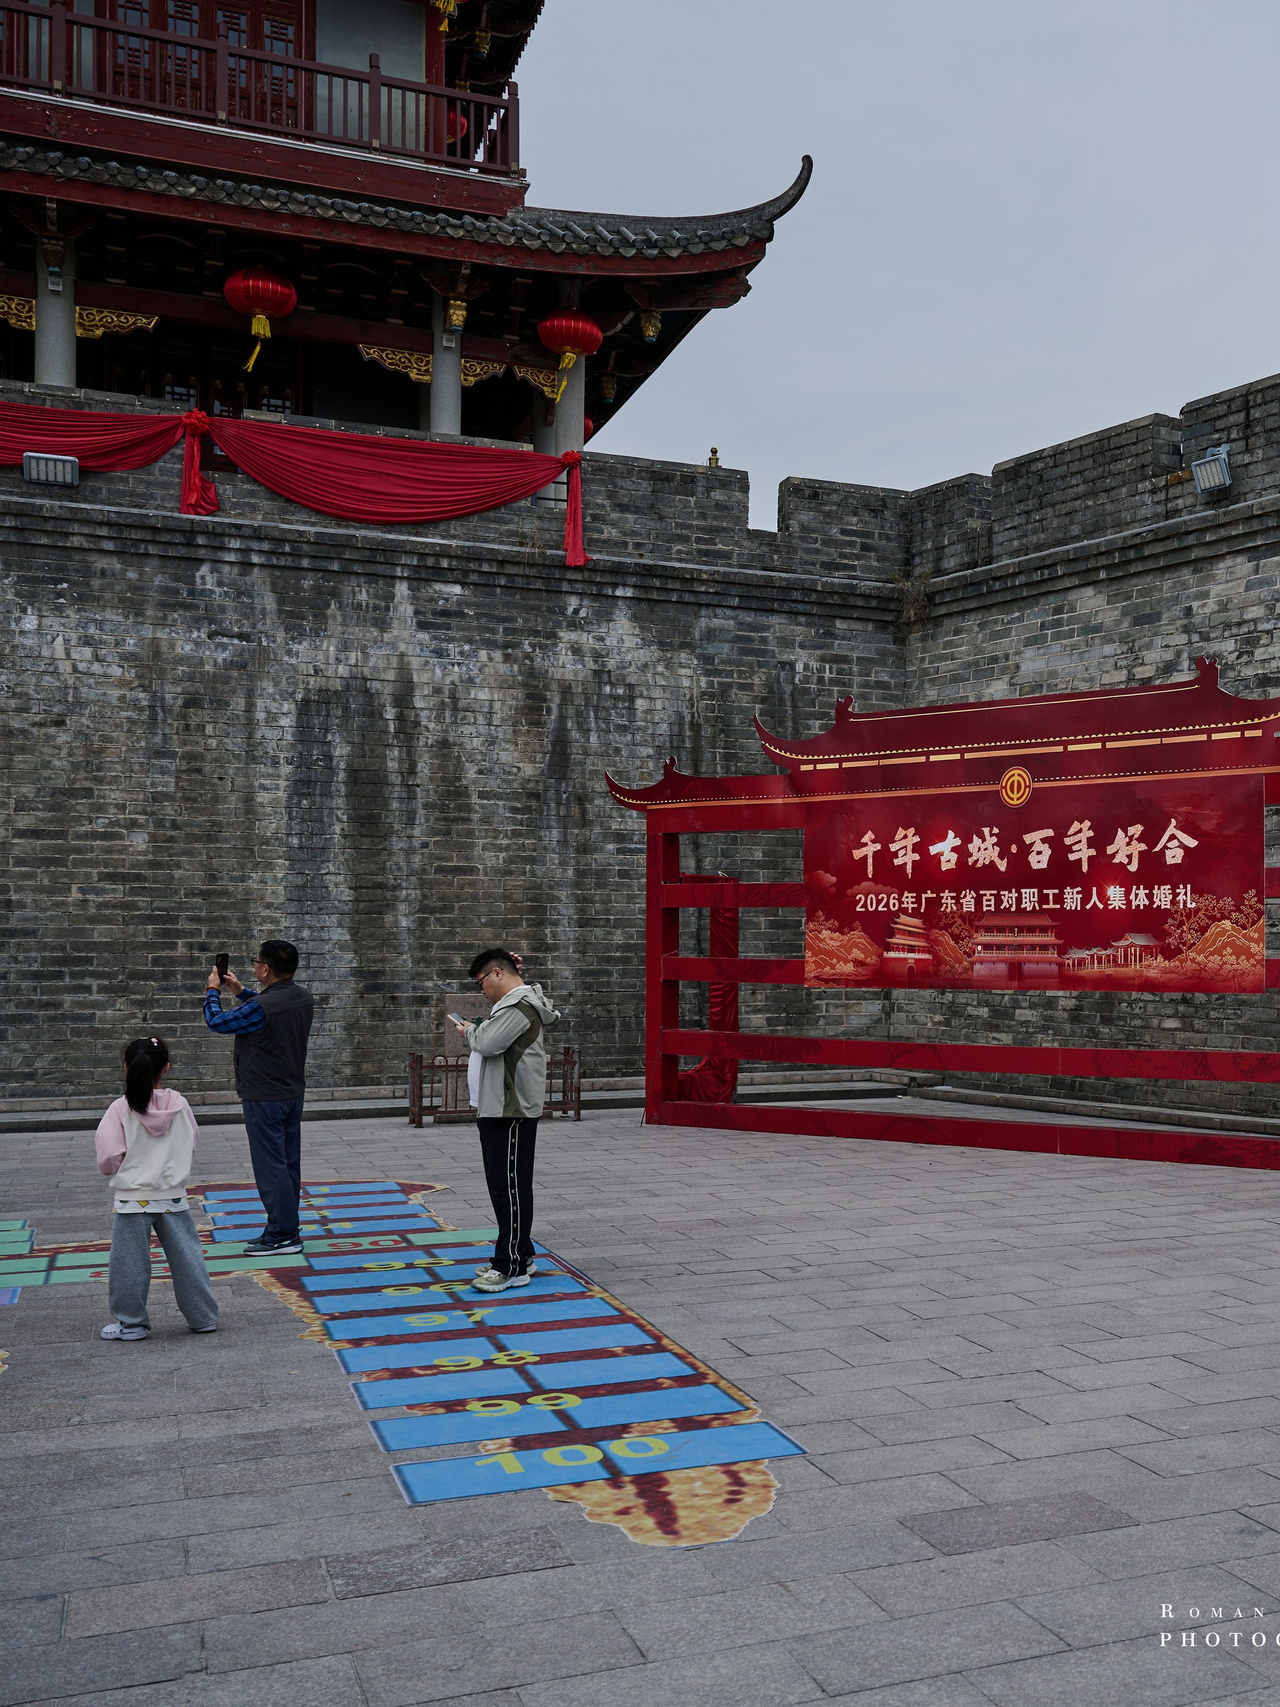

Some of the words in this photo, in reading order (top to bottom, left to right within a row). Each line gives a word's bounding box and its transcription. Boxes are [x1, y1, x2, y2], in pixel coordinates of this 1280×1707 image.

[852, 818, 1199, 879] 千年古城·百年好合
[855, 884, 1197, 914] 2026年广东省百对职工新人集体婚礼
[326, 1239, 404, 1250] 90
[362, 1257, 456, 1271] 95
[381, 1281, 469, 1296] 96
[402, 1309, 495, 1327] 97
[433, 1349, 541, 1371] 98
[465, 1392, 583, 1418] 99
[475, 1436, 670, 1474] 100
